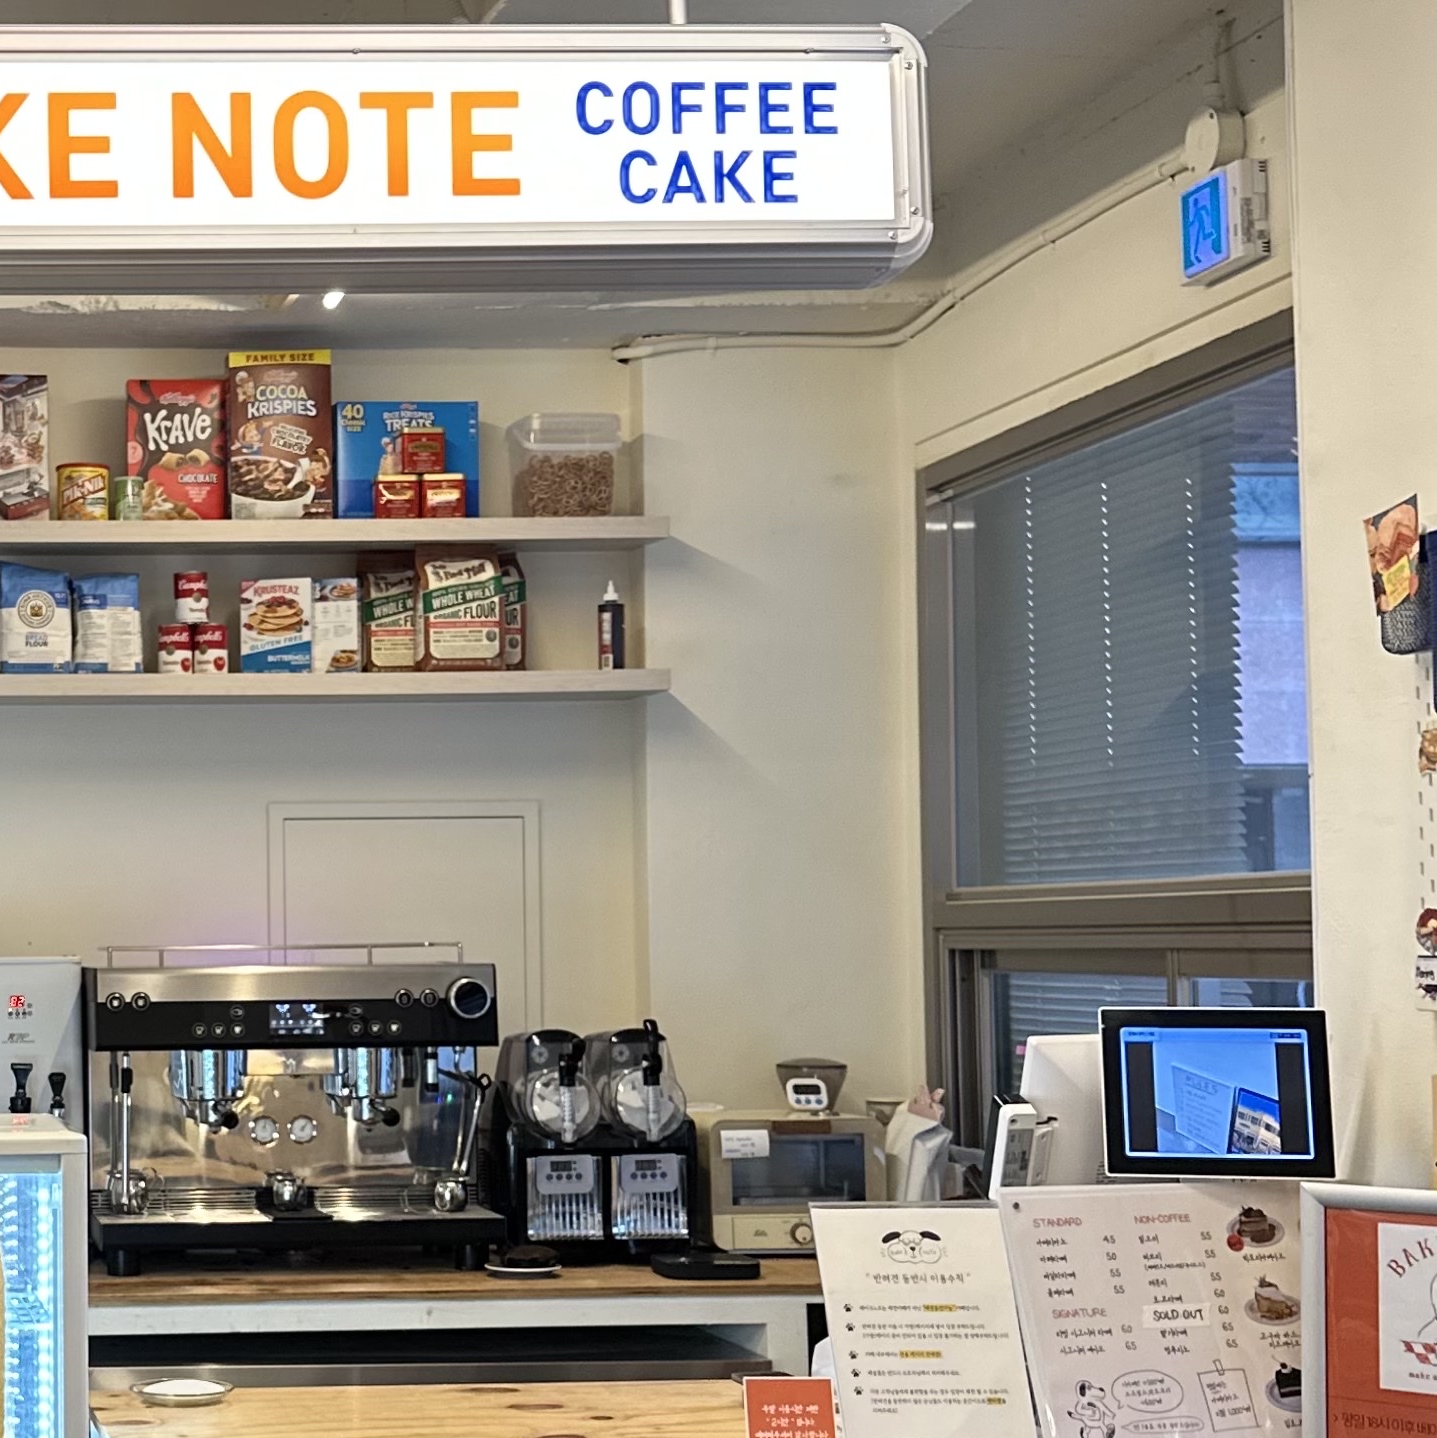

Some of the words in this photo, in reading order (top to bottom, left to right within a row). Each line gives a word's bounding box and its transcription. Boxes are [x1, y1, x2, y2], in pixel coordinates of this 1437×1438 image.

[575, 81, 838, 135] COFFEE
[171, 91, 521, 197] NOTE
[618, 150, 798, 203] CAKE
[246, 354, 286, 363] FAMILY
[290, 353, 314, 361] SIZE
[256, 385, 308, 401] COCOA
[247, 400, 317, 419] KRISPIES
[342, 404, 364, 418] 40
[178, 474, 218, 483] CHOCOLATE
[254, 585, 299, 597] KRUSTEAZ
[432, 592, 463, 610] WHOLE
[465, 585, 495, 600] WHEAT
[463, 601, 497, 619] FLOUR
[250, 639, 282, 651] GLUTEN
[1033, 1217, 1082, 1228] STANDARD
[1134, 1213, 1191, 1224] NON-COFFEE
[1102, 1235, 1116, 1244] 45
[1200, 1231, 1212, 1240] 55
[1106, 1252, 1117, 1261] 50
[1205, 1250, 1216, 1258] 55
[1386, 1237, 1437, 1278] BAK
[1110, 1268, 1121, 1277] 55
[1210, 1272, 1221, 1281] 55
[873, 1273, 899, 1284] 반려견
[902, 1273, 928, 1284] 동반시
[930, 1273, 966, 1284] 이용수칙
[1114, 1285, 1125, 1294] 55
[1214, 1288, 1225, 1297] 60
[1052, 1308, 1107, 1319] SIGNATURE
[1153, 1310, 1179, 1321] SOLD
[1183, 1309, 1203, 1320] OUT
[1218, 1305, 1229, 1314] 60
[1121, 1324, 1132, 1333] 60
[1222, 1322, 1234, 1331] 65
[1125, 1341, 1137, 1350] 65
[1226, 1339, 1238, 1348] 65
